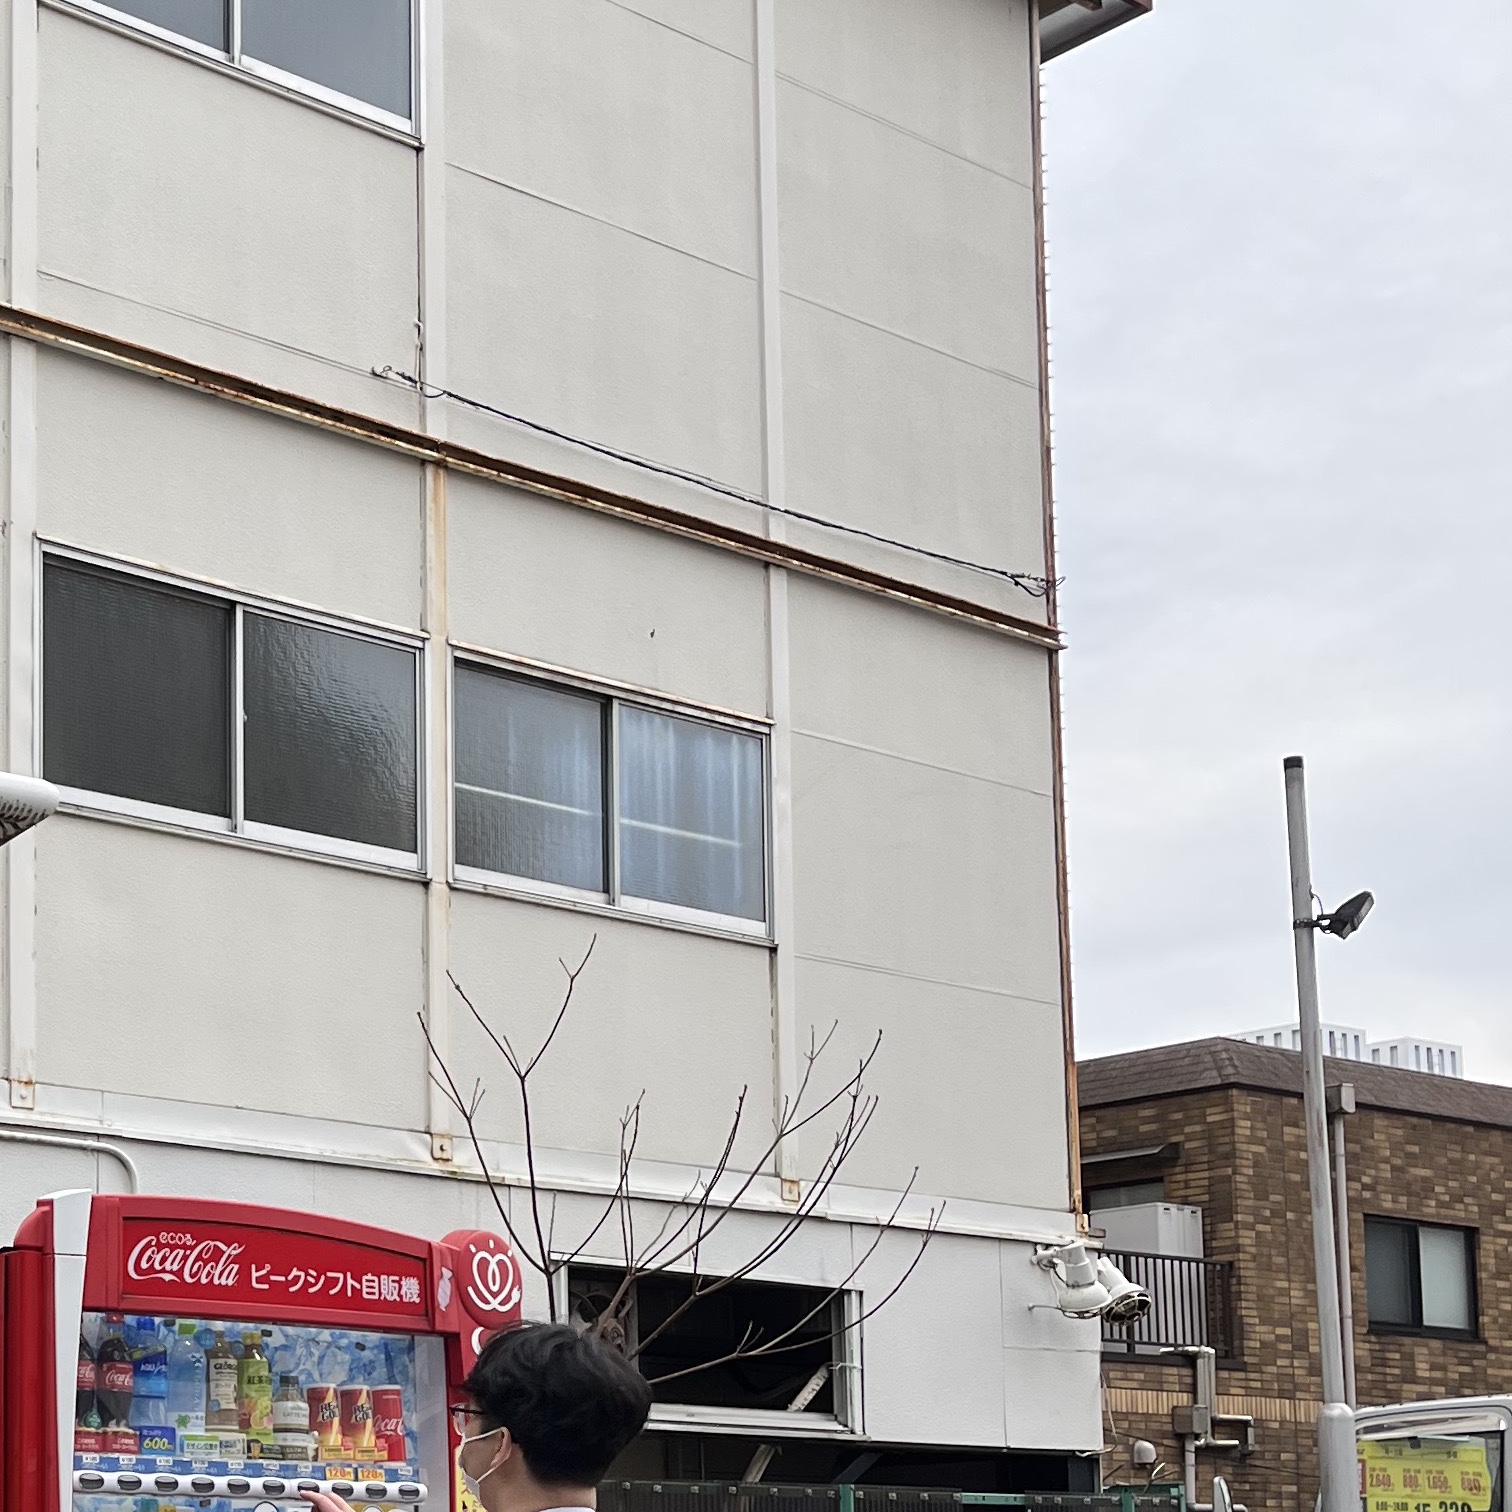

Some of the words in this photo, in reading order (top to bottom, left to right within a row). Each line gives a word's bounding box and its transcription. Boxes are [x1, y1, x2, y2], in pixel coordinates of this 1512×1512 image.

[126, 1236, 246, 1287] Coca-Cola
[250, 1263, 421, 1305] ピークシフト自販機
